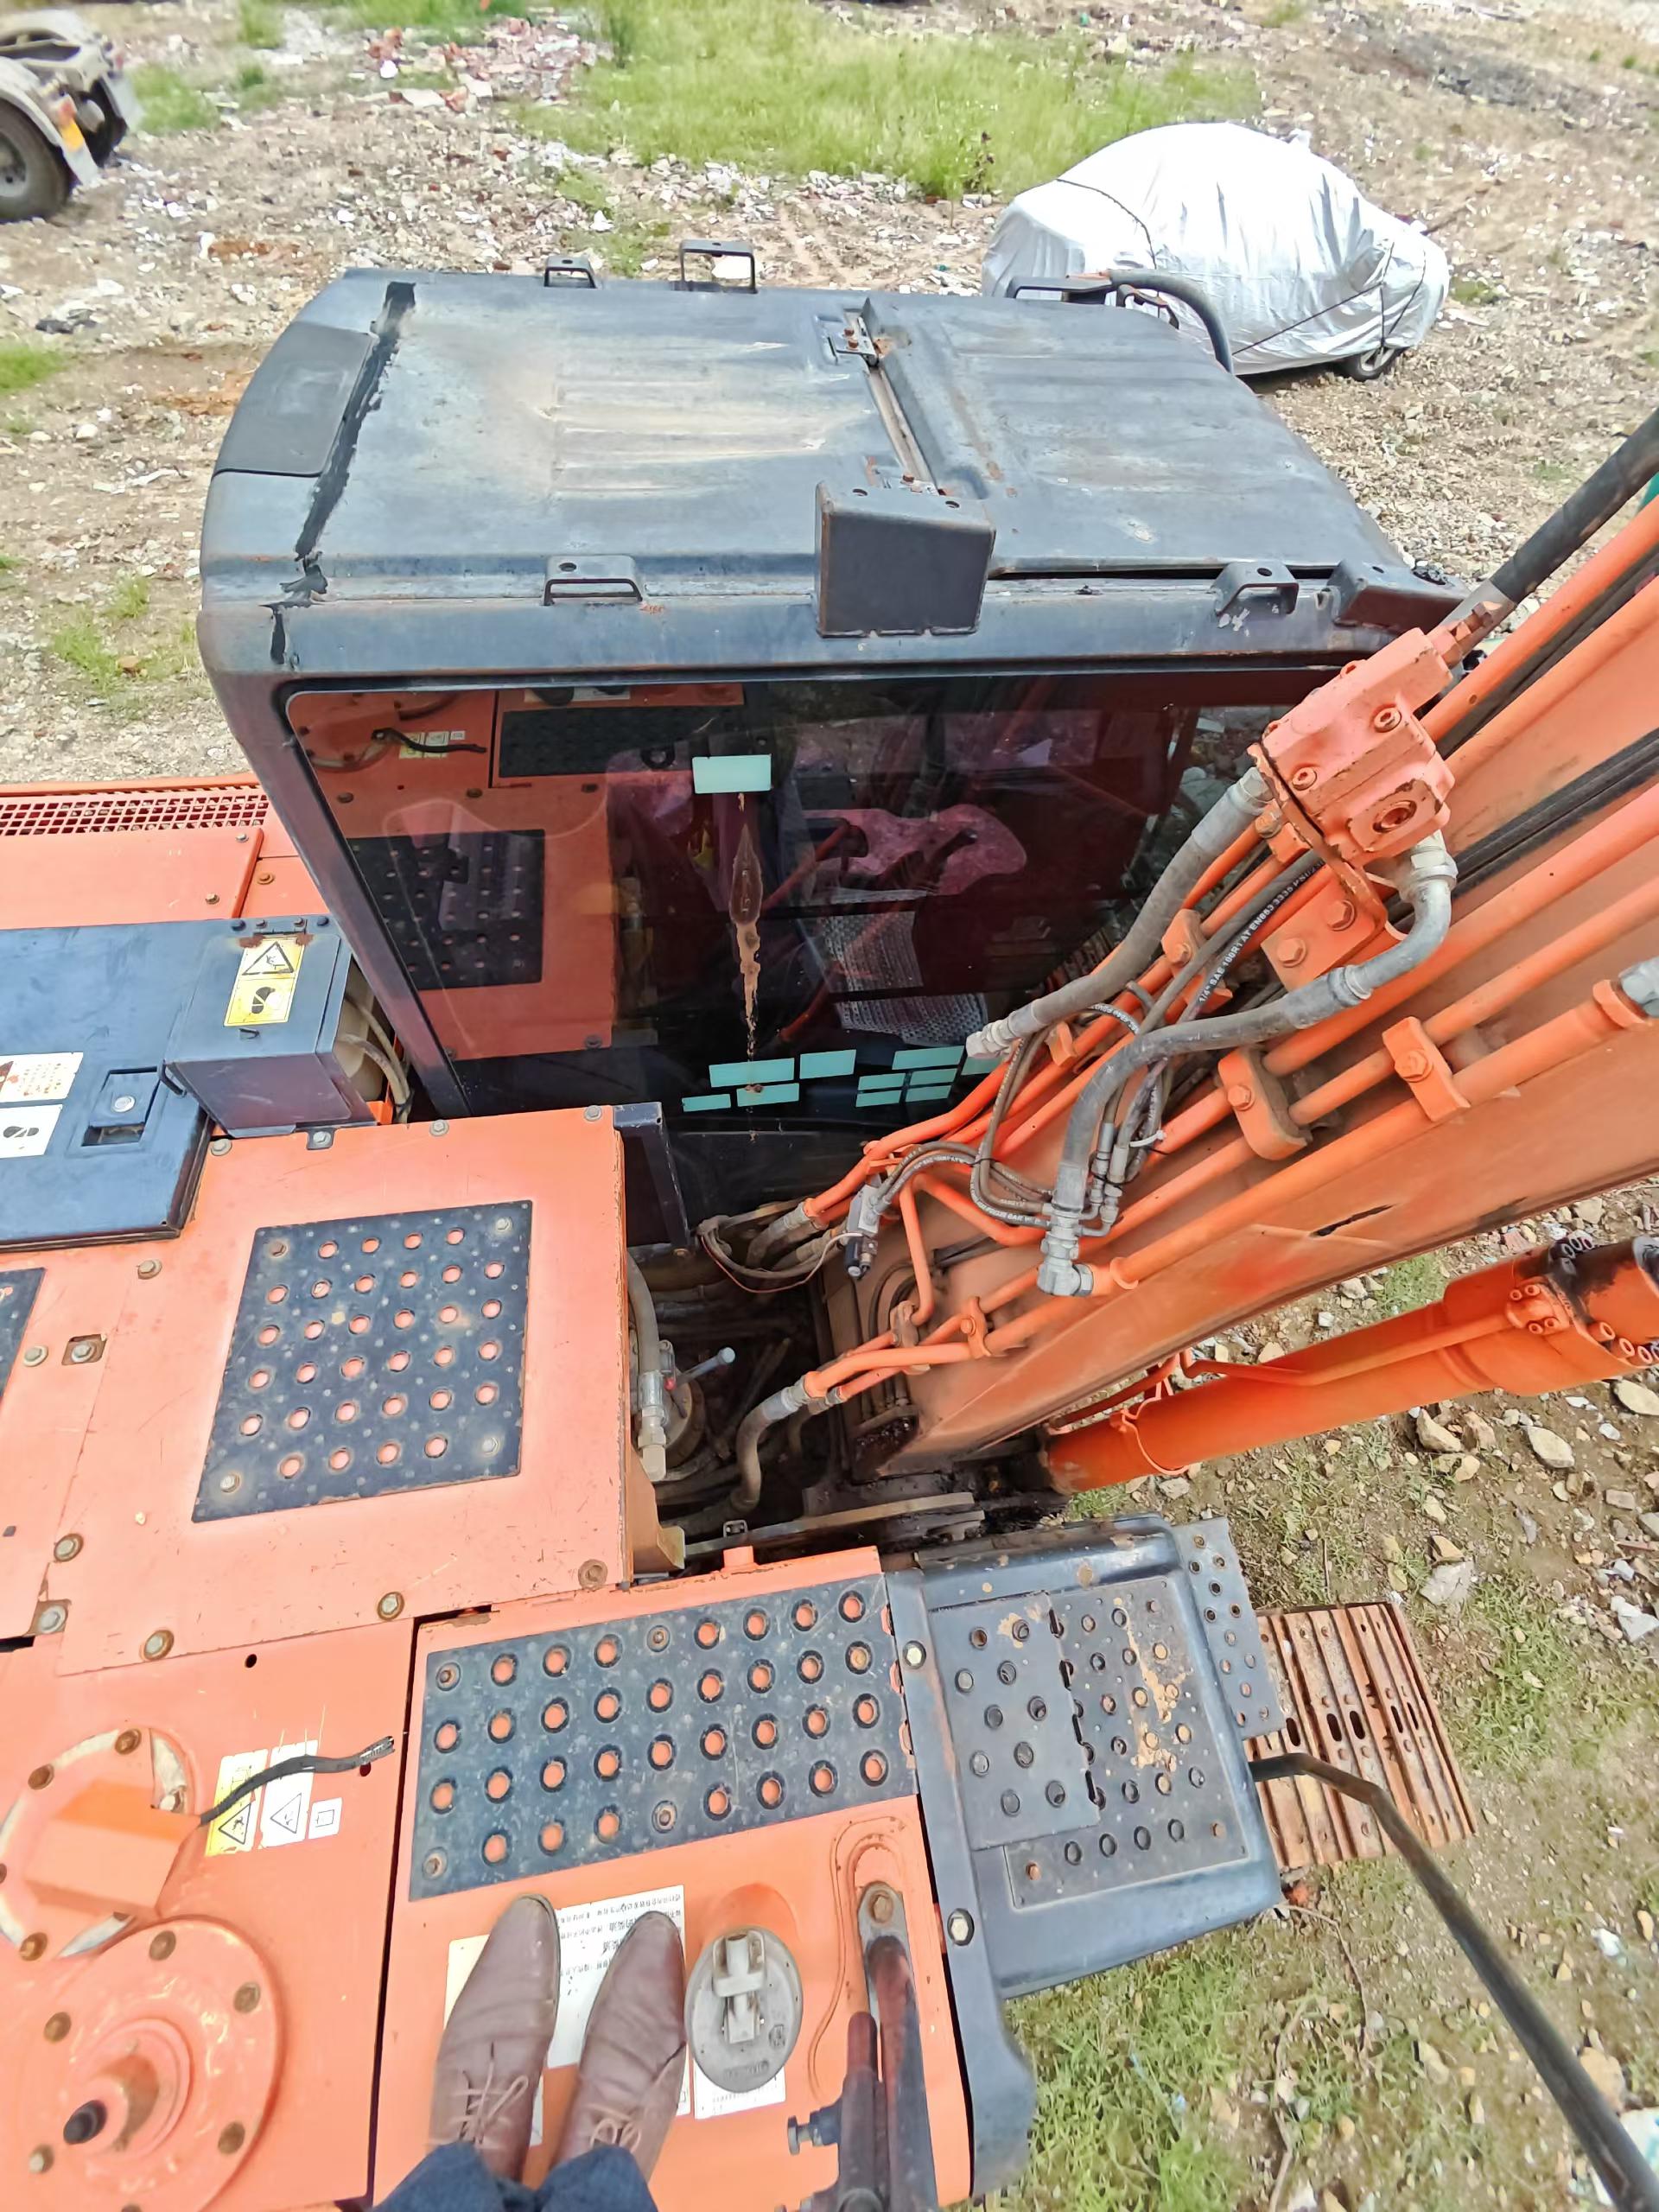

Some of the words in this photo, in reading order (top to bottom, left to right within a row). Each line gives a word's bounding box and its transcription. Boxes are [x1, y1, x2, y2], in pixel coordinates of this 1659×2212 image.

[1209, 965, 1225, 987] SAE
[1222, 938, 1243, 968] 100R1
[1241, 928, 1253, 944] AT
